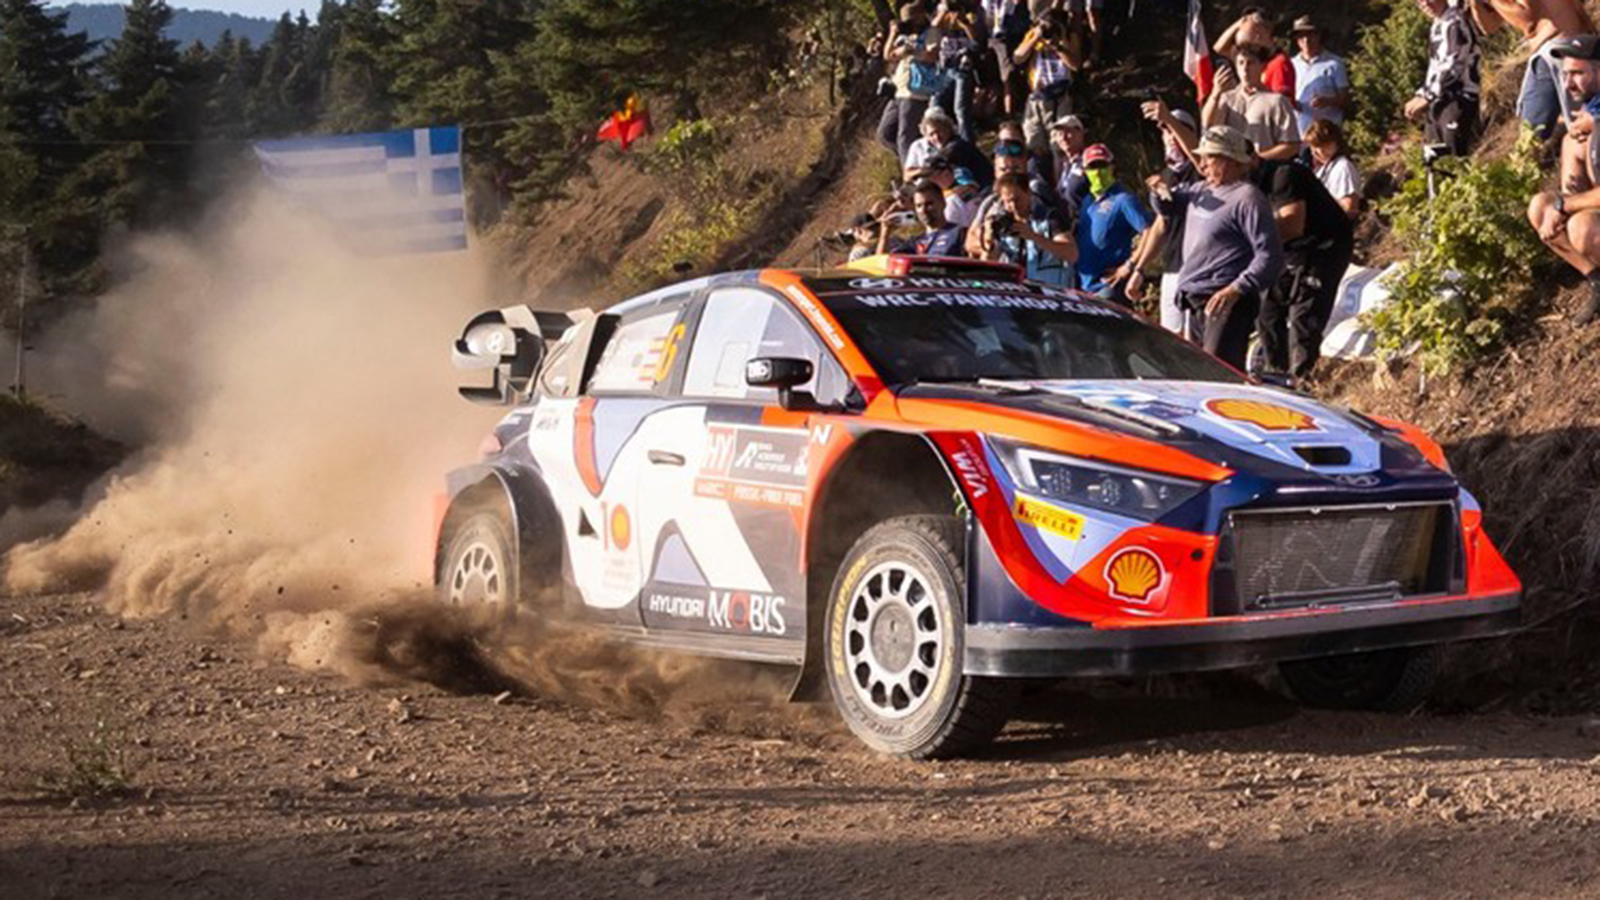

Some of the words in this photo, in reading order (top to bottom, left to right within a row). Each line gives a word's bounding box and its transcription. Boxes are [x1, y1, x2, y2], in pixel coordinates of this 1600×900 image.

[855, 294, 1122, 319] WRC-FANSHOP.COM
[655, 322, 686, 382] 6
[649, 593, 705, 618] HYUNDAI
[707, 589, 787, 636] MOBIS
